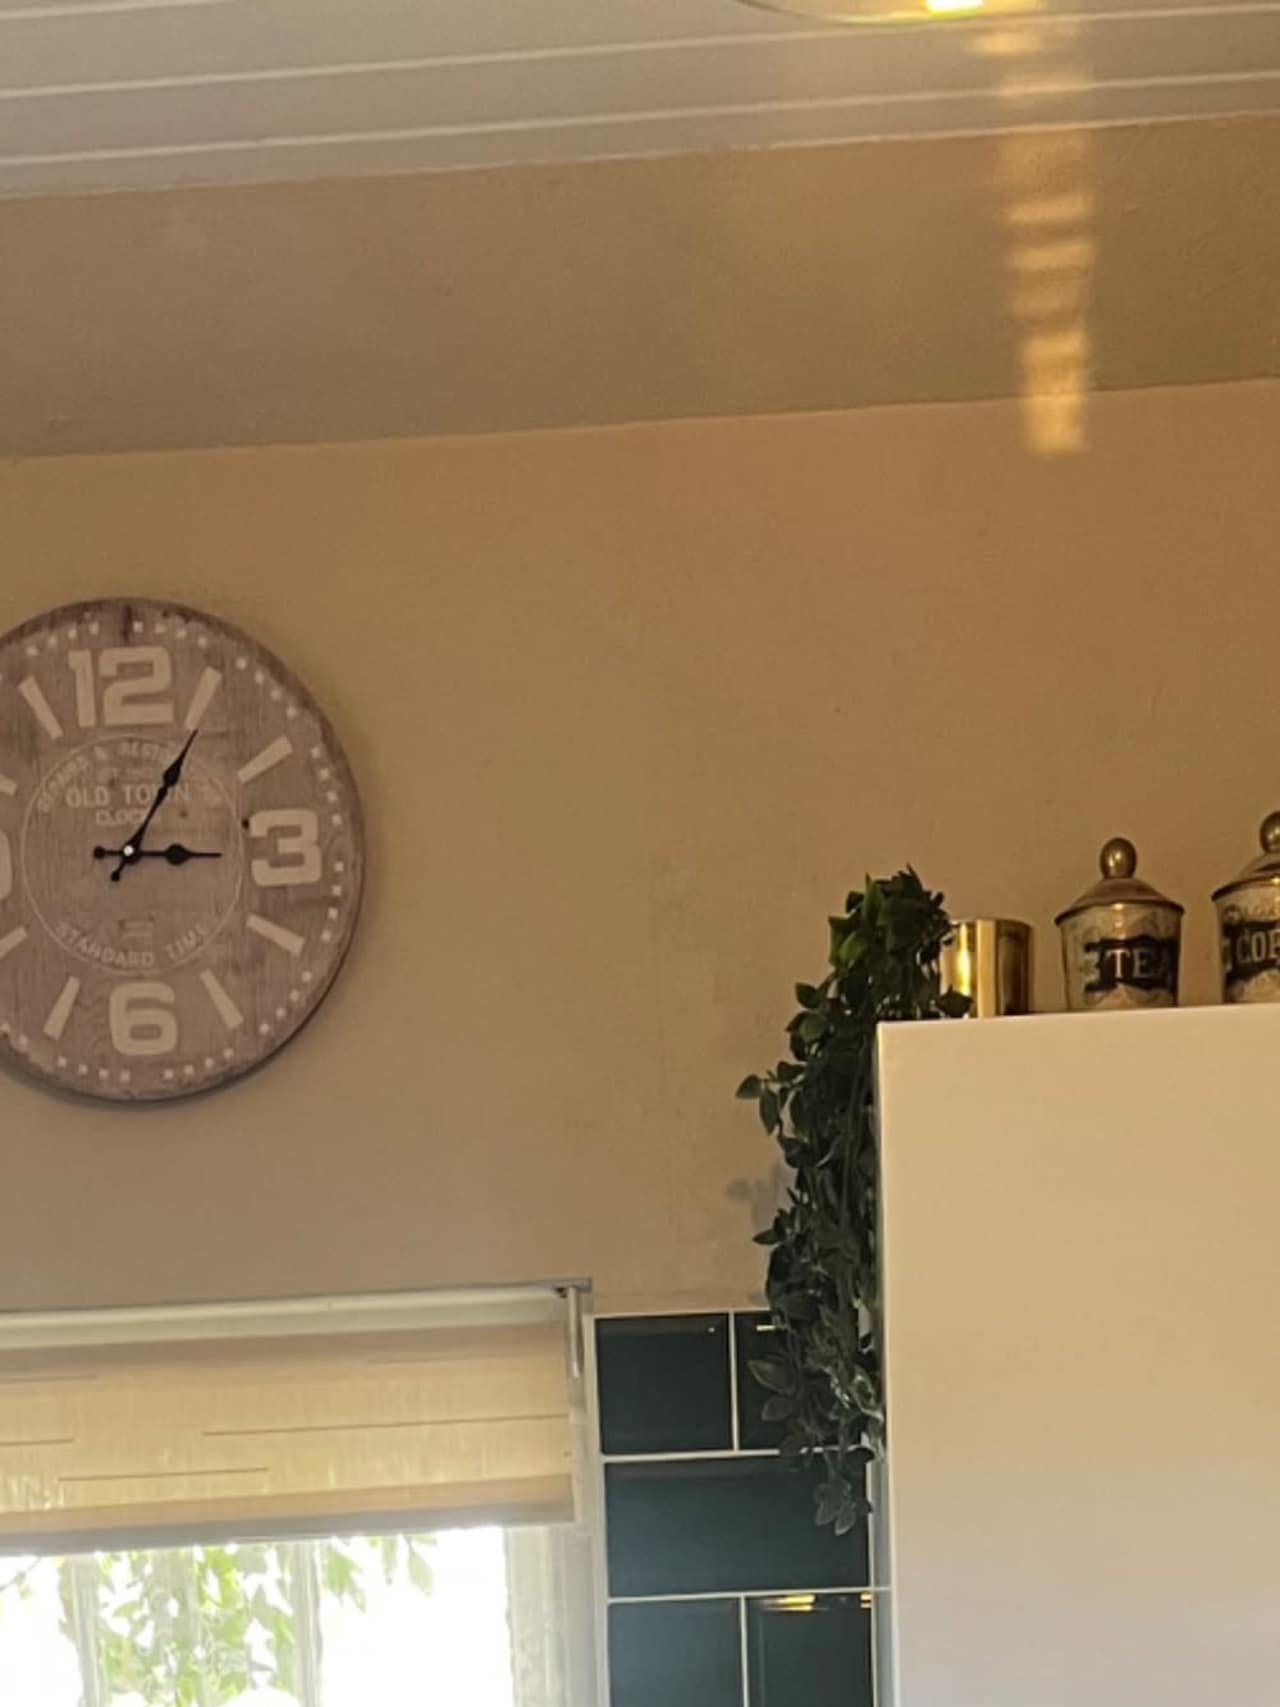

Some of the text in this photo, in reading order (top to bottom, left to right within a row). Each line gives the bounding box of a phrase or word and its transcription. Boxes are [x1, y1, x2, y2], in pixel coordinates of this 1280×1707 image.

[68, 646, 174, 728] 12
[65, 785, 110, 809] OLD
[248, 808, 321, 887] 3
[108, 980, 179, 1056] 6
